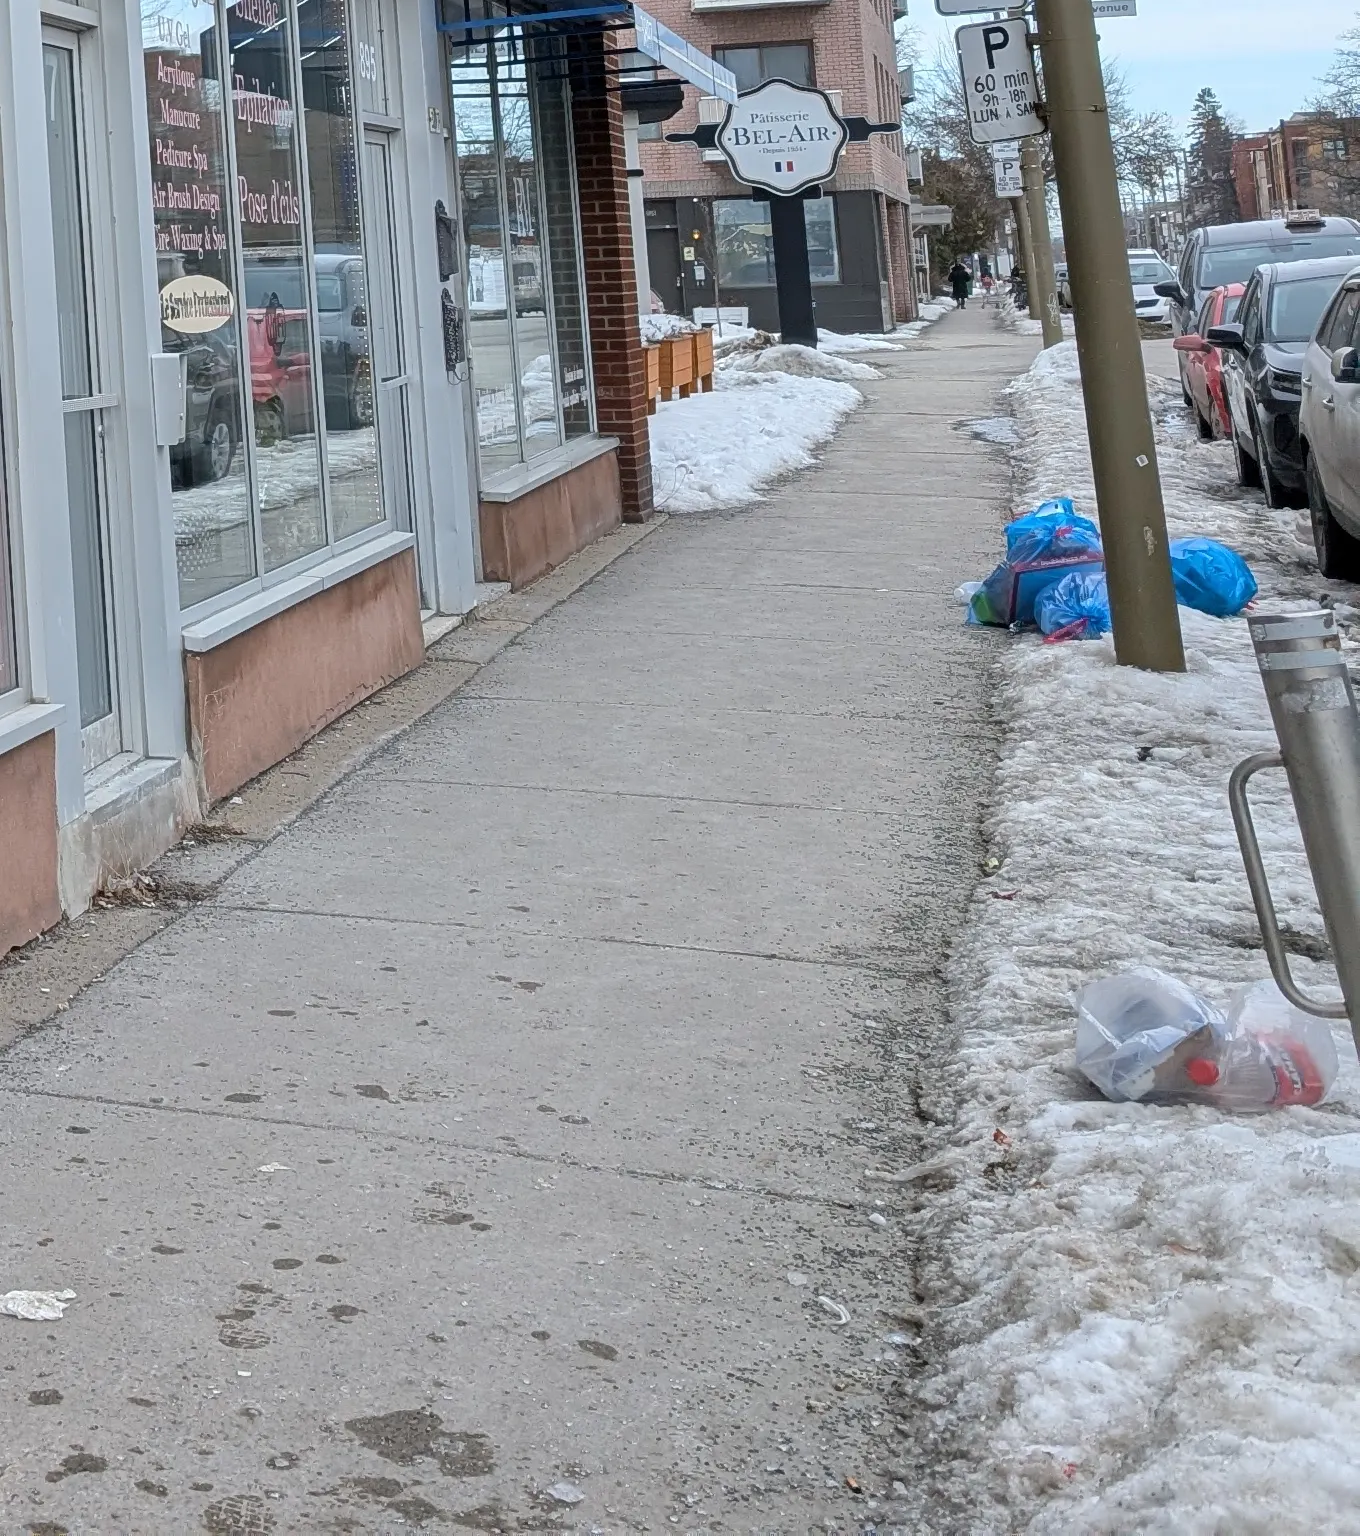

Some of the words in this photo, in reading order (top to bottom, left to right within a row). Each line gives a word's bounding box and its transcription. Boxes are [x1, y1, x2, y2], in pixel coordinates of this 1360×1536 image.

[1092, 4, 1129, 13] venue
[981, 25, 1010, 70] P
[157, 56, 196, 96] Acrylique
[974, 75, 996, 94] 60
[1004, 68, 1030, 88] min
[750, 110, 809, 124] Pâtisserie
[972, 108, 999, 124] LUN
[156, 139, 192, 170] Pedicure
[193, 144, 208, 179] Spa
[167, 182, 192, 210] Brush
[193, 184, 221, 219] Design
[237, 175, 268, 224] Pose
[170, 224, 204, 259] Waxing
[204, 225, 211, 251] &
[212, 226, 227, 259] Spa
